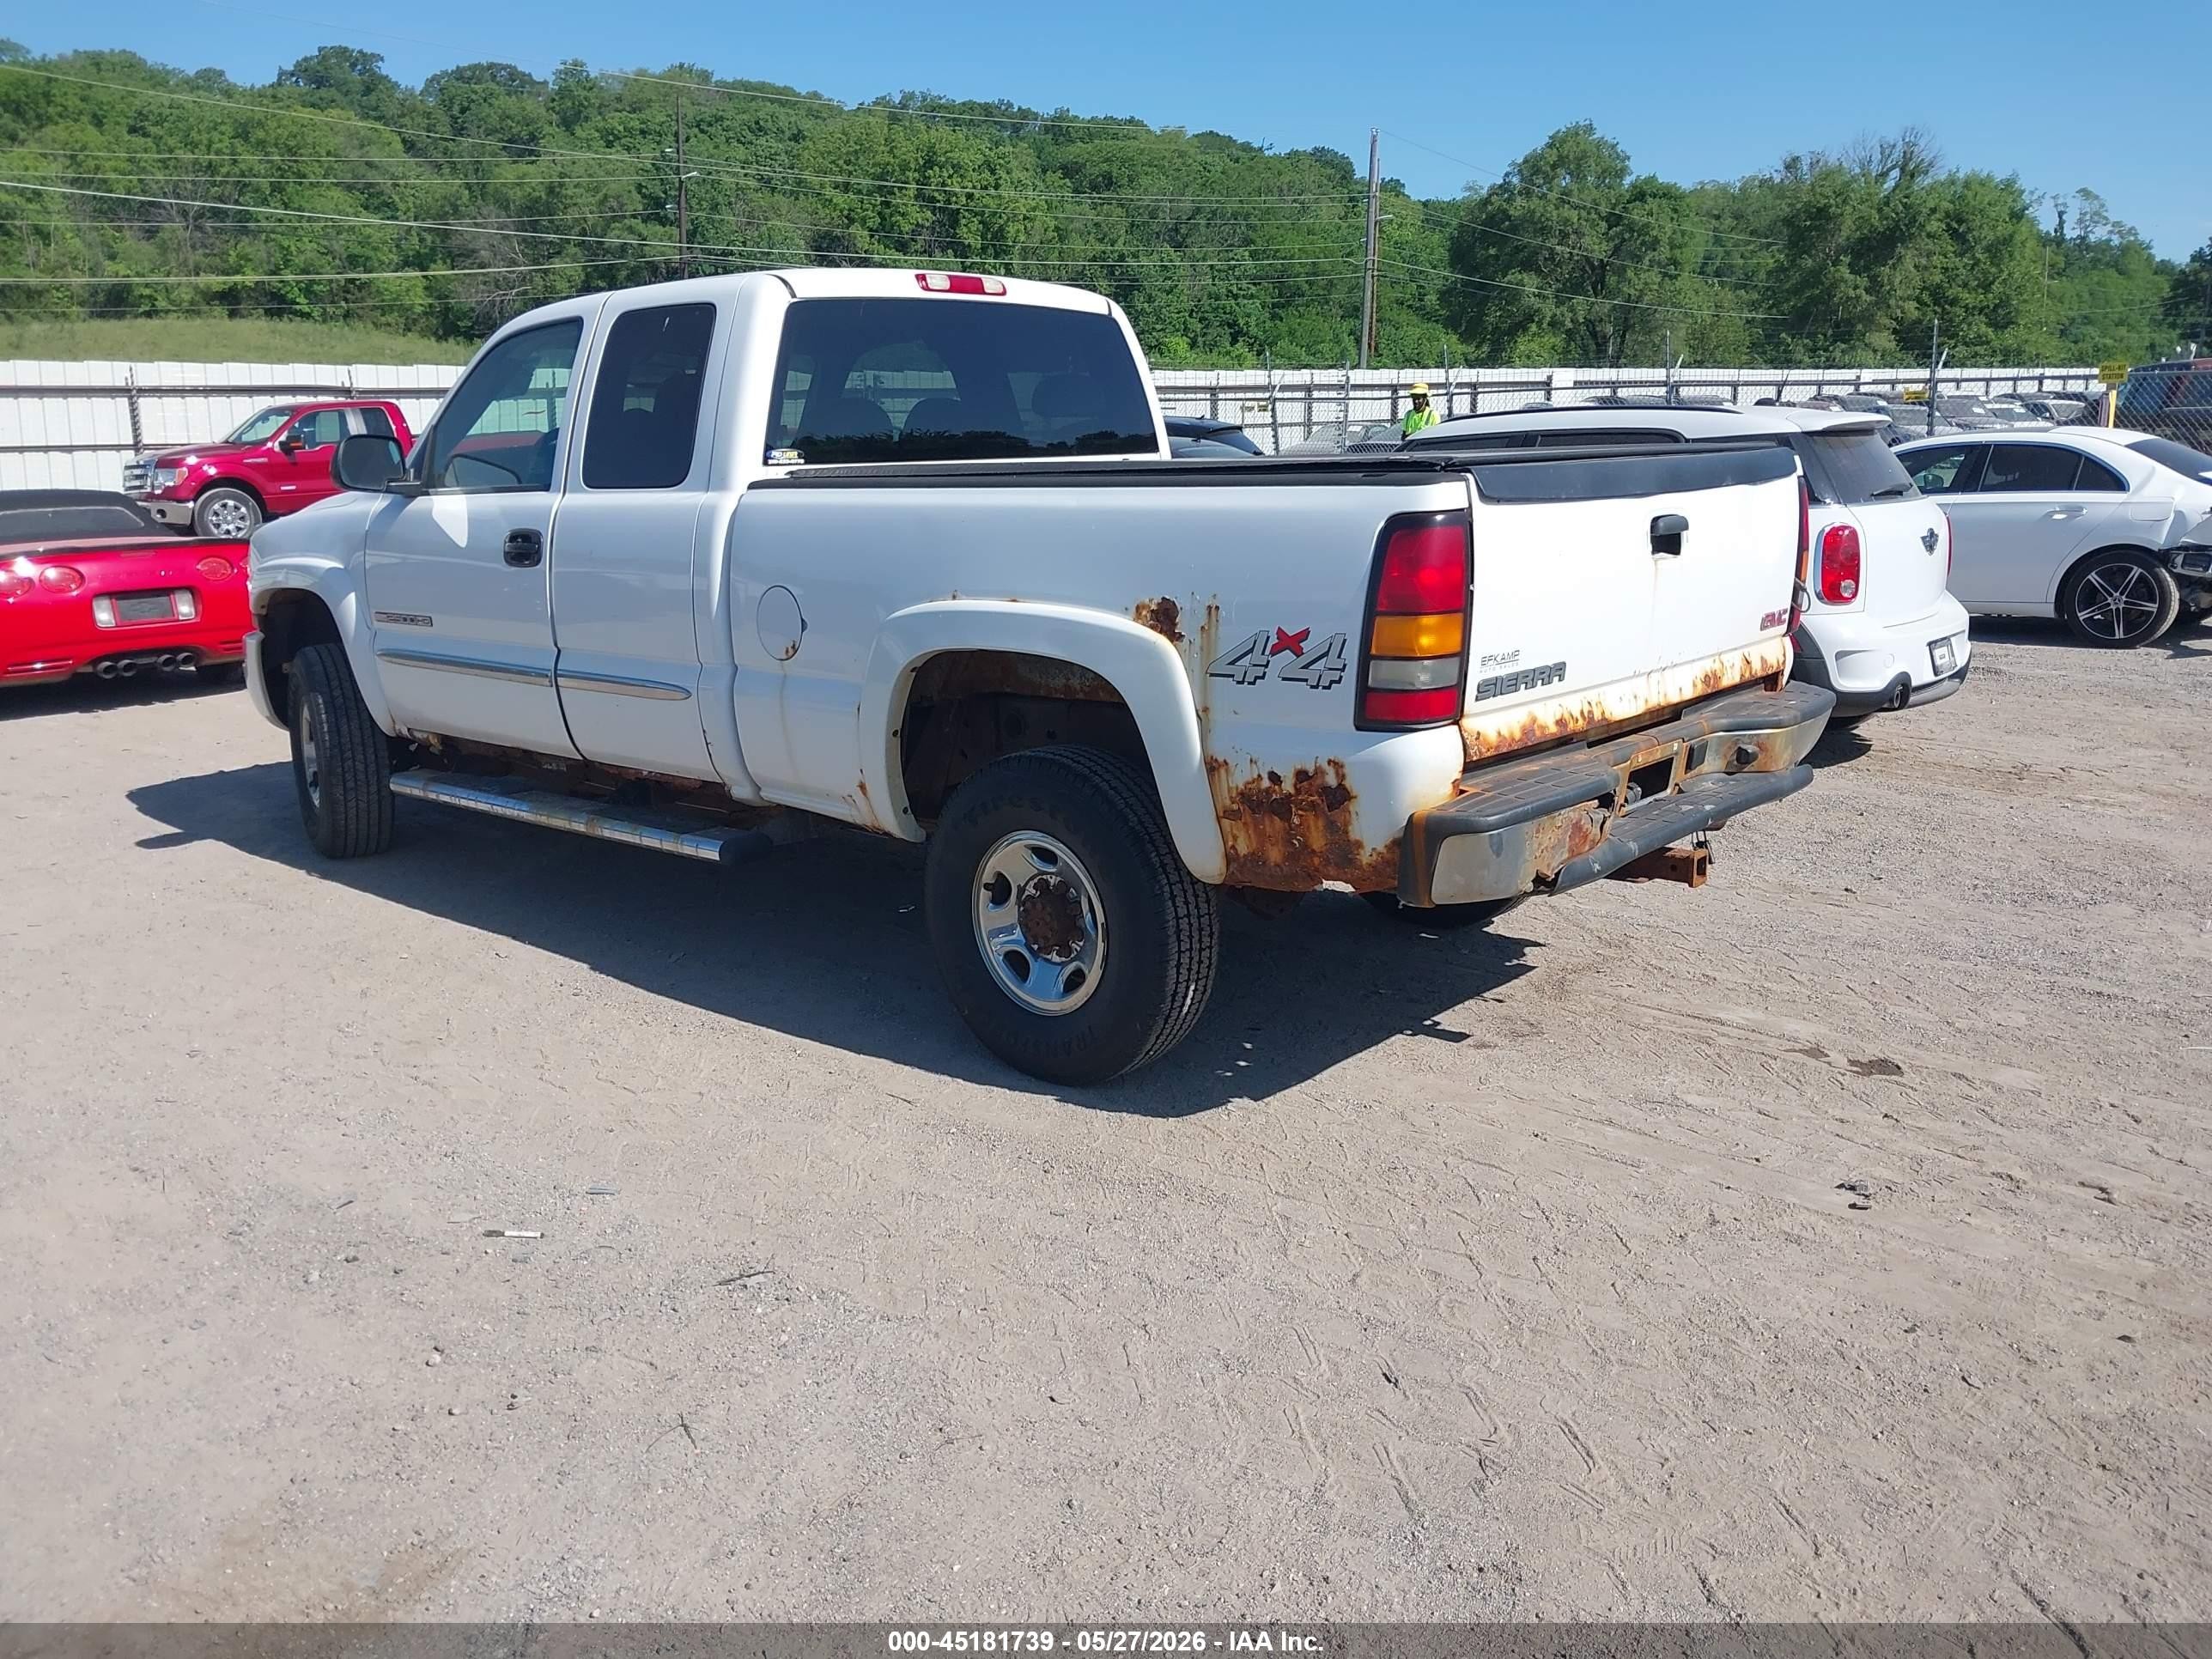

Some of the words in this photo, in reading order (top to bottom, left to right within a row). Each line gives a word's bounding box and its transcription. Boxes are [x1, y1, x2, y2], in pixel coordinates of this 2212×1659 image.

[2102, 372, 2124, 380] STATION
[1760, 608, 1788, 631] GMC
[1480, 649, 1520, 666] EFKAMP
[1474, 660, 1566, 702] SIERRA
